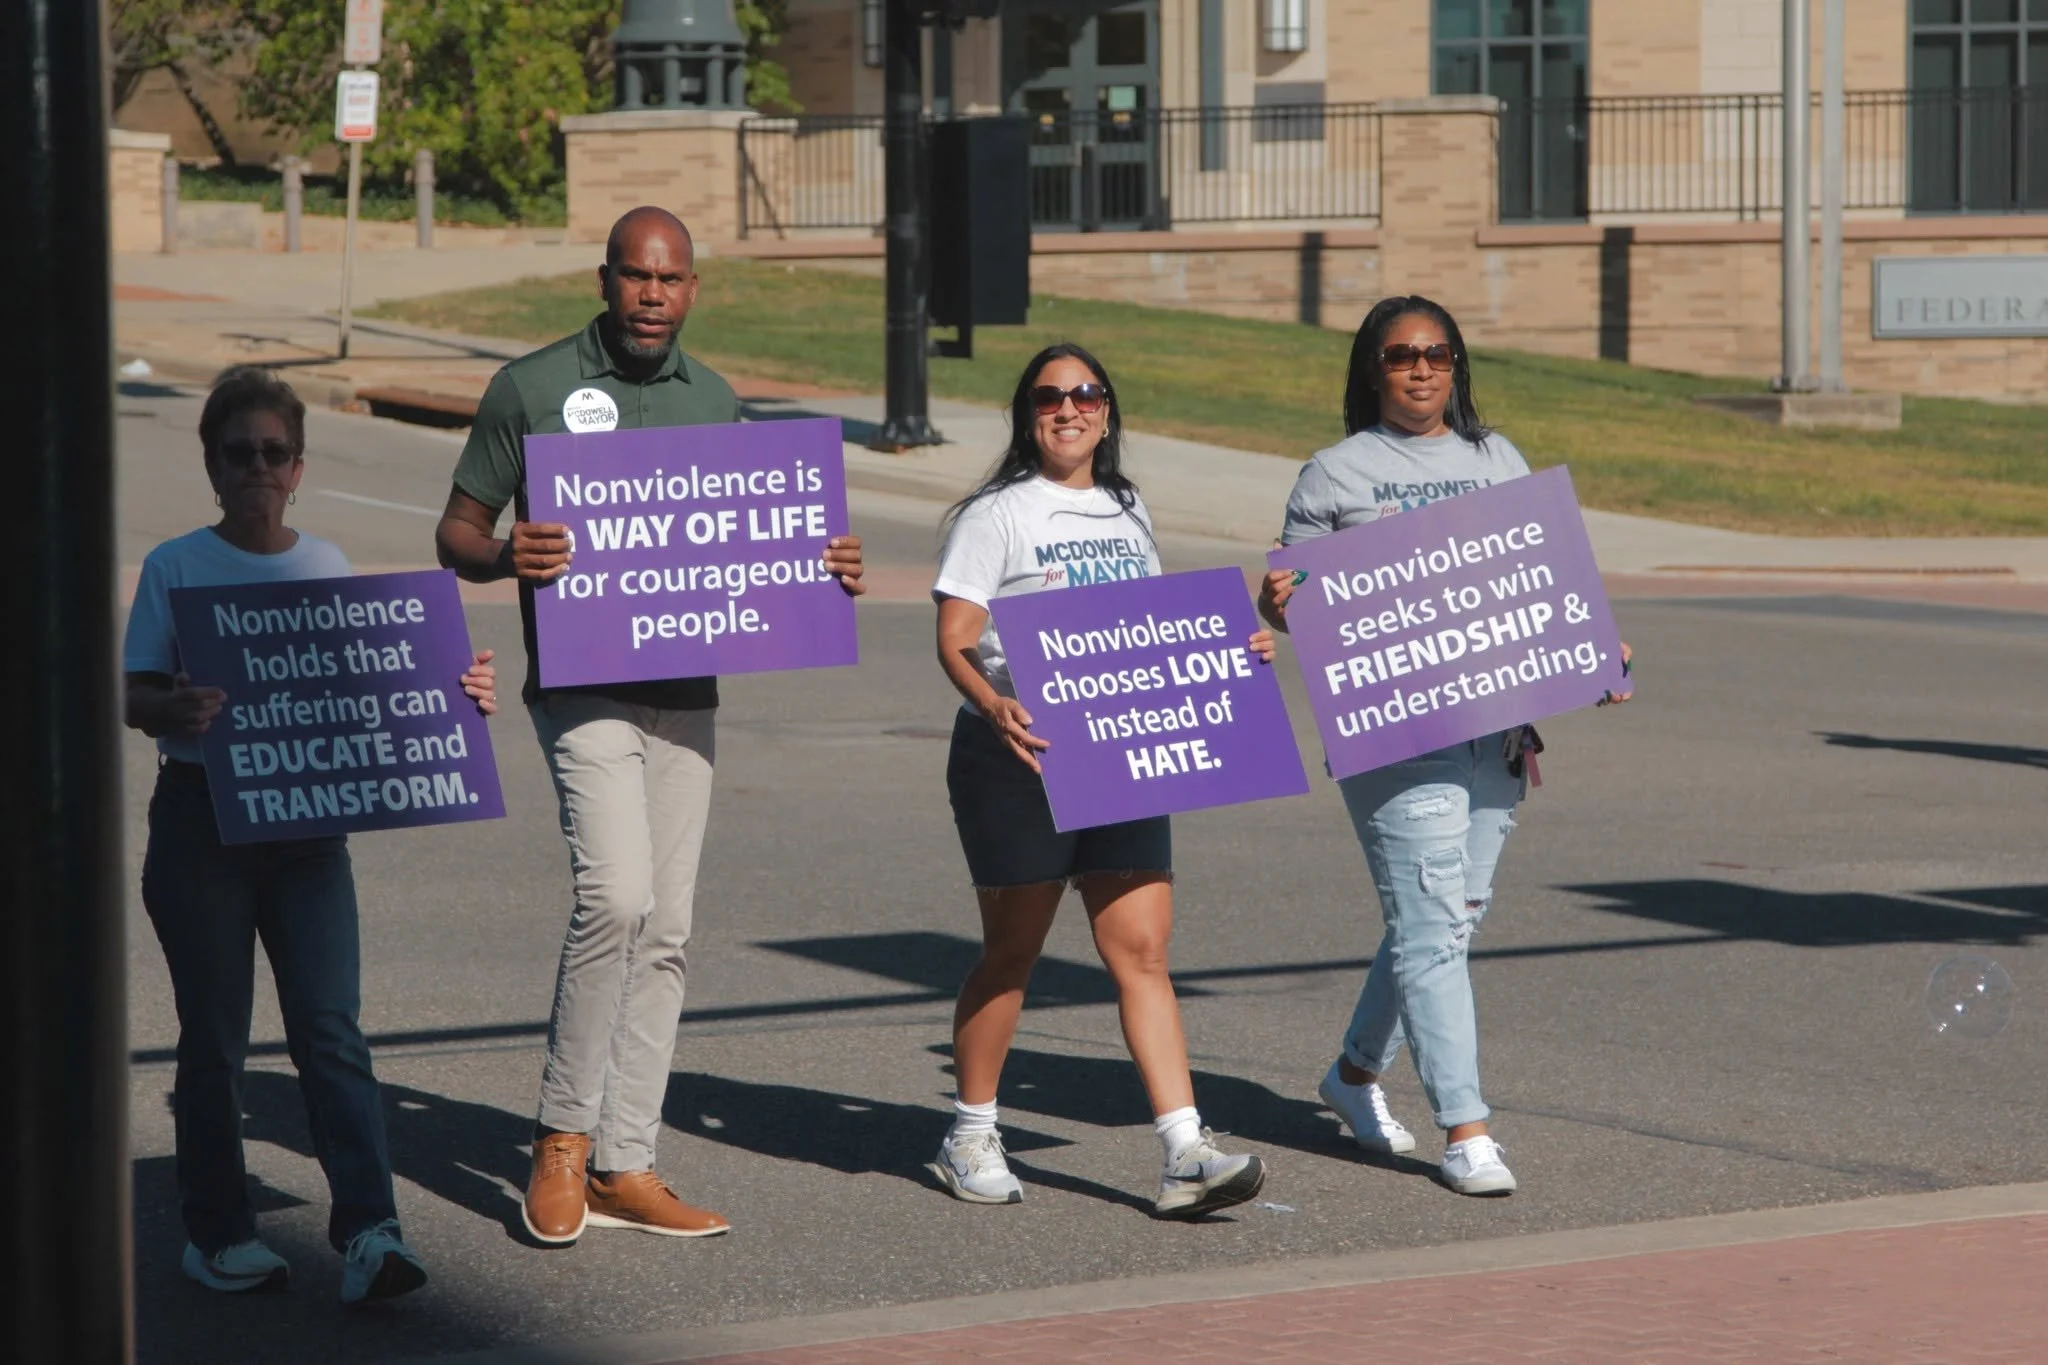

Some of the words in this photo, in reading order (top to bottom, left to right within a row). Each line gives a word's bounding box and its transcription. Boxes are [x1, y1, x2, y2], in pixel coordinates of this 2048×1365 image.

[578, 413, 616, 425] MAYOR
[554, 465, 786, 508] Nonviolence
[795, 460, 823, 492] is
[586, 514, 674, 551] WAY
[686, 511, 737, 544] OF
[749, 505, 827, 541] LIFE
[1035, 539, 1146, 567] MCDOWELL
[1321, 522, 1544, 606] Nonviolence
[620, 559, 833, 596] courageous
[1041, 568, 1065, 587] for
[213, 594, 425, 637] Nonviolence
[631, 601, 770, 649] people.
[1339, 598, 1437, 646] seeks
[1443, 586, 1482, 614] to
[1488, 563, 1554, 600] win
[243, 643, 338, 682] holds
[344, 639, 416, 674] that
[1038, 614, 1227, 661] Nonviolence
[1325, 602, 1553, 695] FRIENDSHIP
[1564, 592, 1591, 624] &
[1042, 664, 1166, 704] chooses
[1168, 647, 1252, 686] LOVE
[1336, 641, 1607, 737] understanding.
[231, 690, 381, 730] suffering
[389, 688, 448, 717] can
[1085, 696, 1199, 742] instead
[1204, 690, 1233, 724] of
[229, 732, 397, 777] EDUCATE
[404, 723, 469, 763] and
[1126, 739, 1222, 780] HATE.
[238, 772, 479, 824] TRANSFORM.
